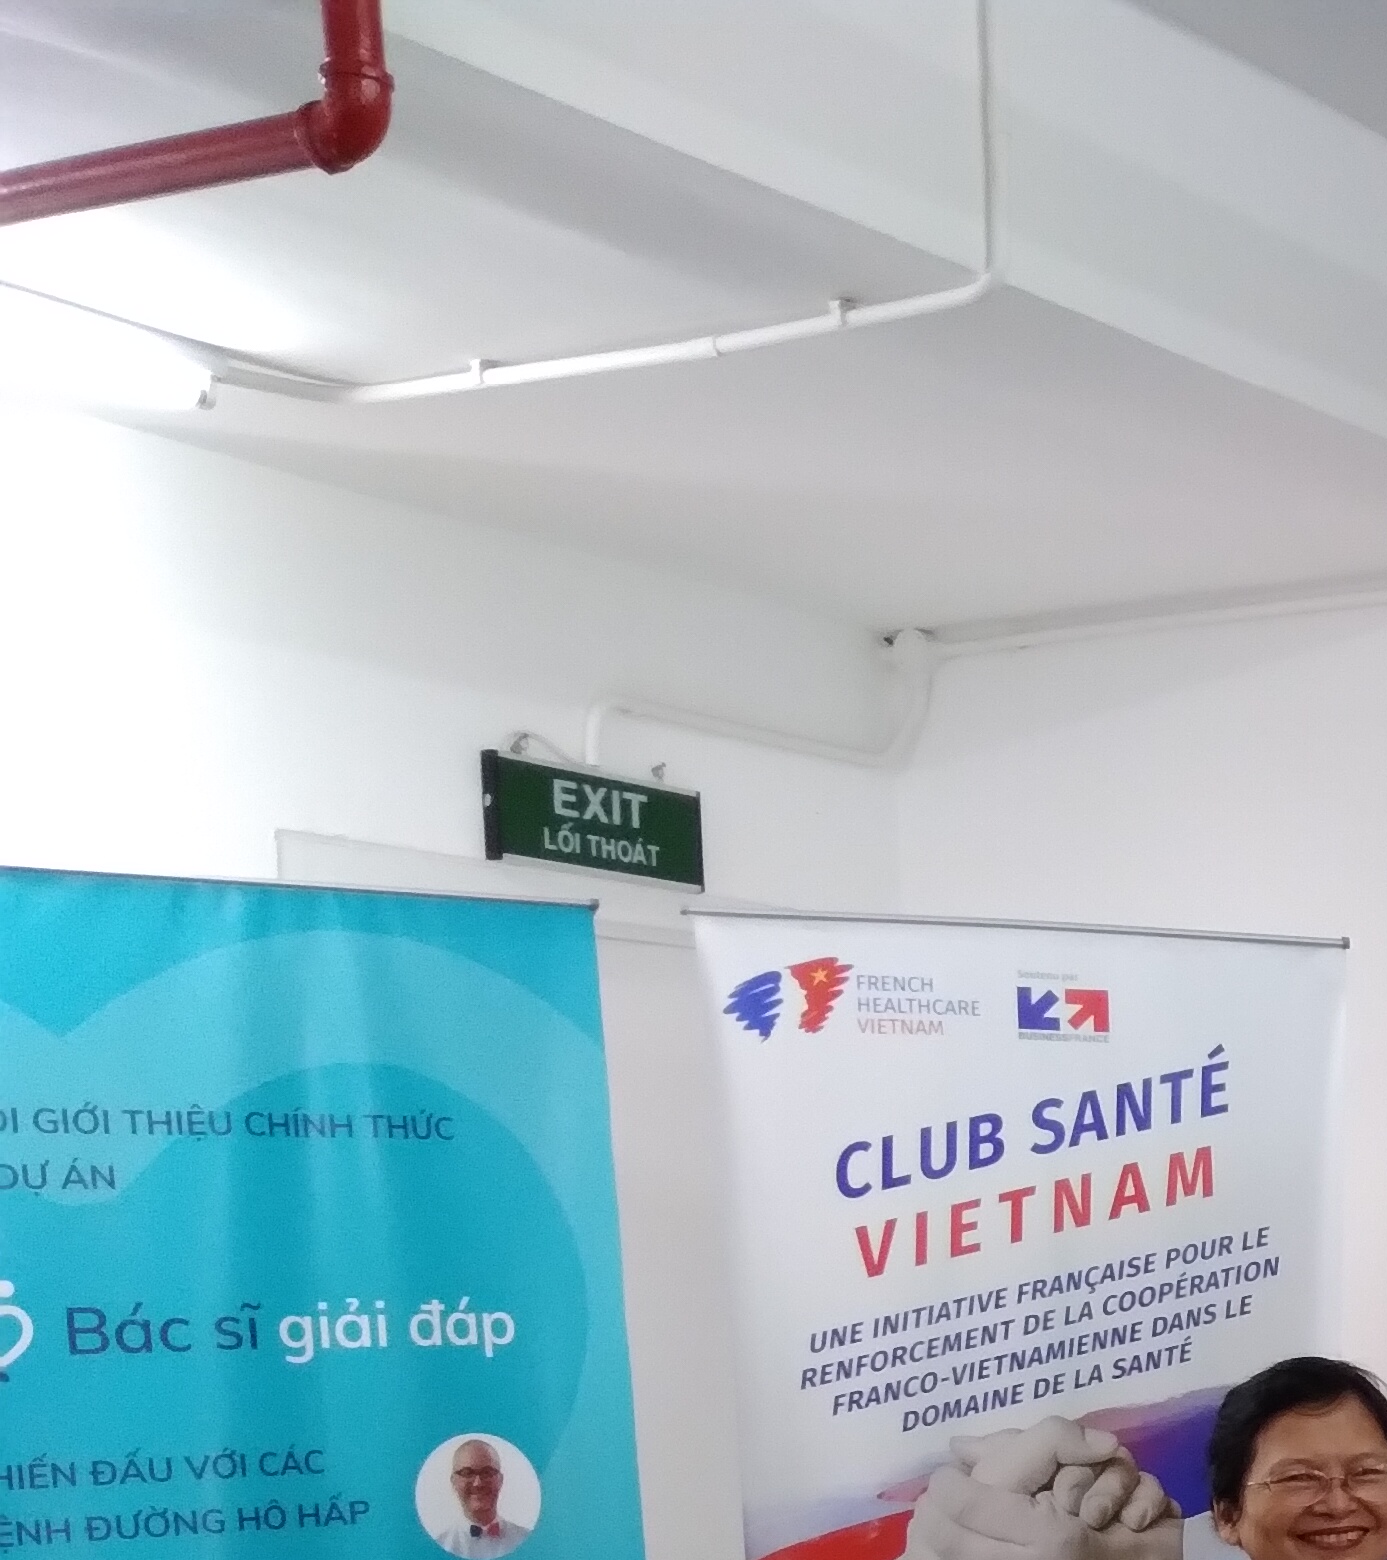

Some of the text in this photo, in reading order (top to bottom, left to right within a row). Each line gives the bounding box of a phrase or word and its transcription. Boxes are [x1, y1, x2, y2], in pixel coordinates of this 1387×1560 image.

[553, 778, 648, 828] EXIT
[543, 822, 660, 867] LỐI THOÁT
[856, 974, 934, 993] FRENCH
[857, 997, 981, 1016] HEALTHCARE
[857, 1018, 944, 1035] VIETNAM
[33, 1101, 110, 1135] GIỚI
[122, 1103, 233, 1141] THIỆU
[244, 1107, 353, 1138] CHÍNH
[362, 1109, 455, 1140] THỨC
[836, 1043, 1230, 1199] CLUB SANTÉ
[62, 1157, 116, 1190] ÁN
[855, 1145, 1214, 1279] VIETNAM
[810, 1226, 1270, 1354] UNE INITIATIVE FRANÇAISE POUR LE
[66, 1296, 515, 1364] Bác sĩ giải đáp
[800, 1256, 1279, 1390] RENFORCEMENT DE LA COOPÉRATION
[832, 1294, 1253, 1416] FRANCO-VIETNAMIENNE DANS LE
[902, 1336, 1193, 1432] DOMAINE DE LA SANTÉ
[89, 1448, 172, 1486] ĐẤU
[184, 1447, 247, 1480] VỚI
[259, 1444, 325, 1477] CÁC
[85, 1506, 226, 1542] ĐƯỜNG
[237, 1499, 287, 1531] HÔ
[297, 1491, 370, 1528] HẤP
